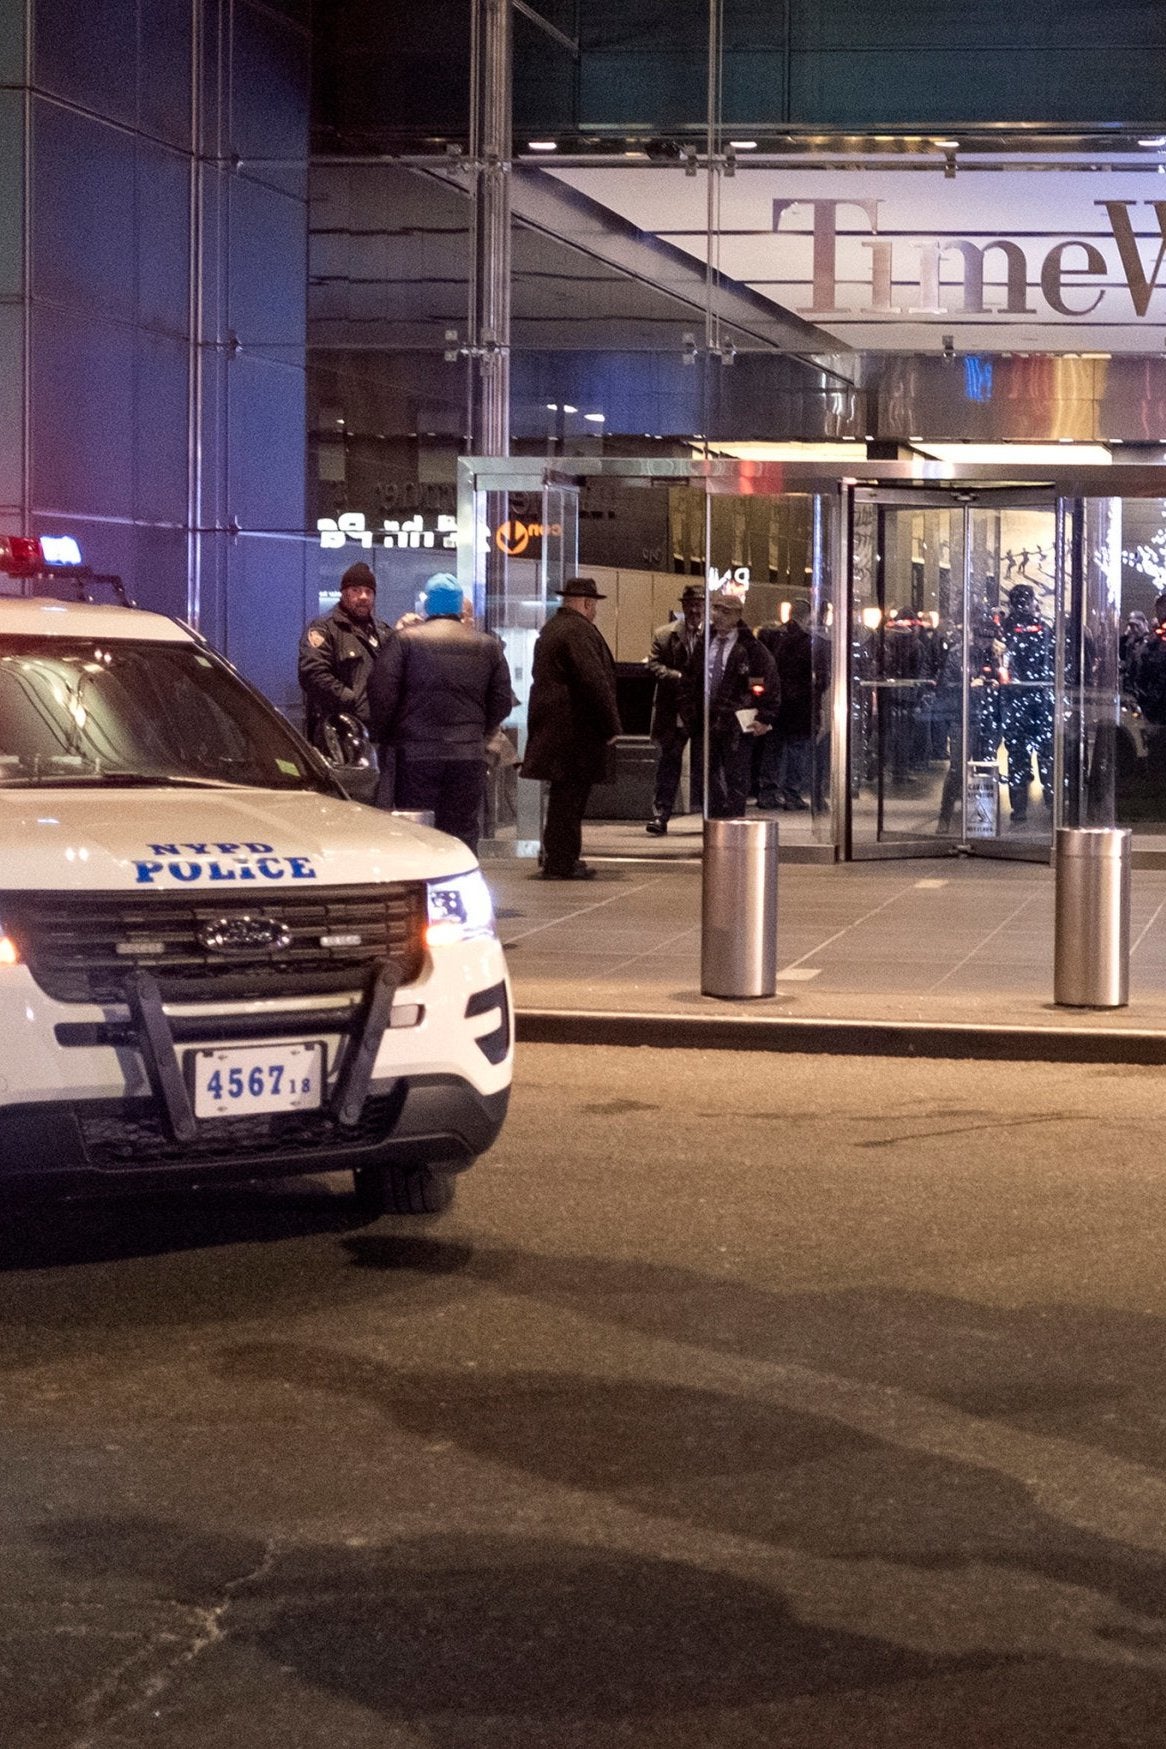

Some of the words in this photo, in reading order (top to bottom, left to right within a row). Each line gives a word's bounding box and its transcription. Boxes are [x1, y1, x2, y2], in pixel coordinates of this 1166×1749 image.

[146, 842, 274, 856] NYPD
[131, 856, 317, 884] POLICE
[207, 1064, 285, 1100] 4567
